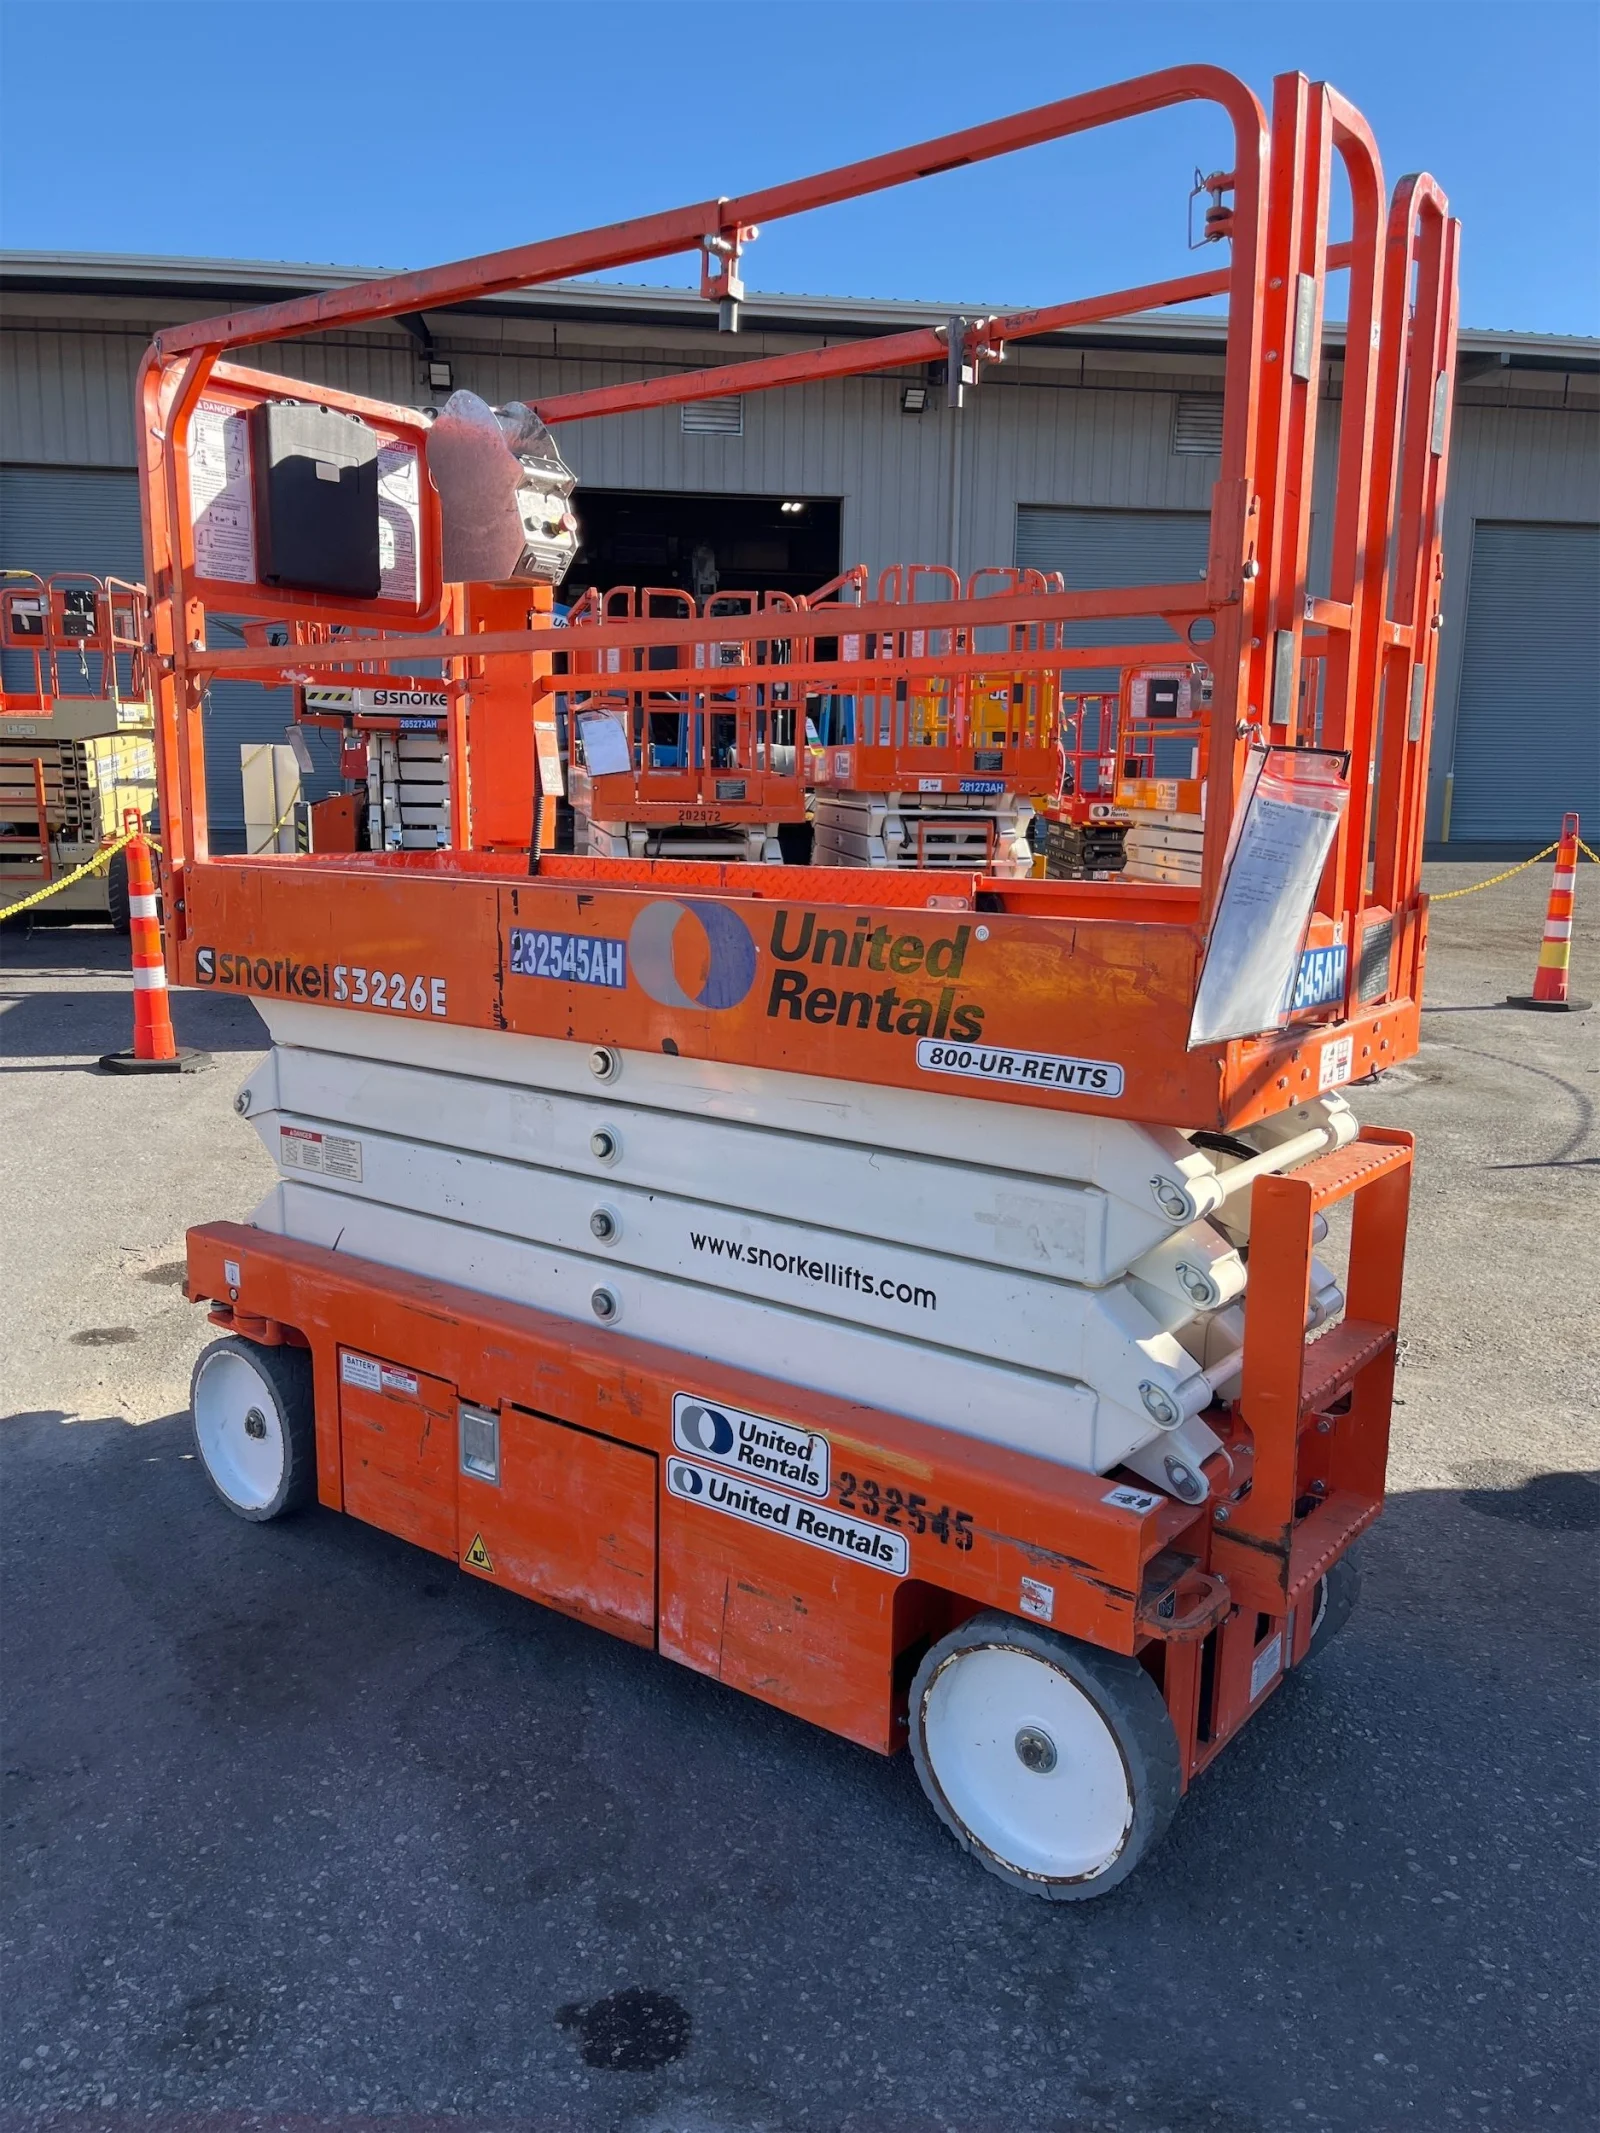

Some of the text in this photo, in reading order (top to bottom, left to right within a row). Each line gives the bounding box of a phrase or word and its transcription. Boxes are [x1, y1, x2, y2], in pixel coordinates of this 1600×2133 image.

[202, 401, 237, 416] DANGER
[389, 692, 448, 706] snorke
[400, 719, 437, 729] 265273AH
[678, 809, 721, 822] 202972
[511, 932, 623, 986] 232545AH
[770, 910, 971, 979] United
[219, 953, 330, 1000] snorkel
[333, 964, 448, 1017] S3226E
[767, 968, 985, 1044] Rentals
[929, 1047, 1109, 1089] 800-UR-RENTS
[690, 1232, 937, 1311] www.snorkellifts.com
[346, 1355, 376, 1372] BATTERY
[738, 1421, 813, 1462] United
[737, 1443, 819, 1486] Rentals
[709, 1478, 894, 1562] United Rentals
[838, 1471, 974, 1551] 232545
